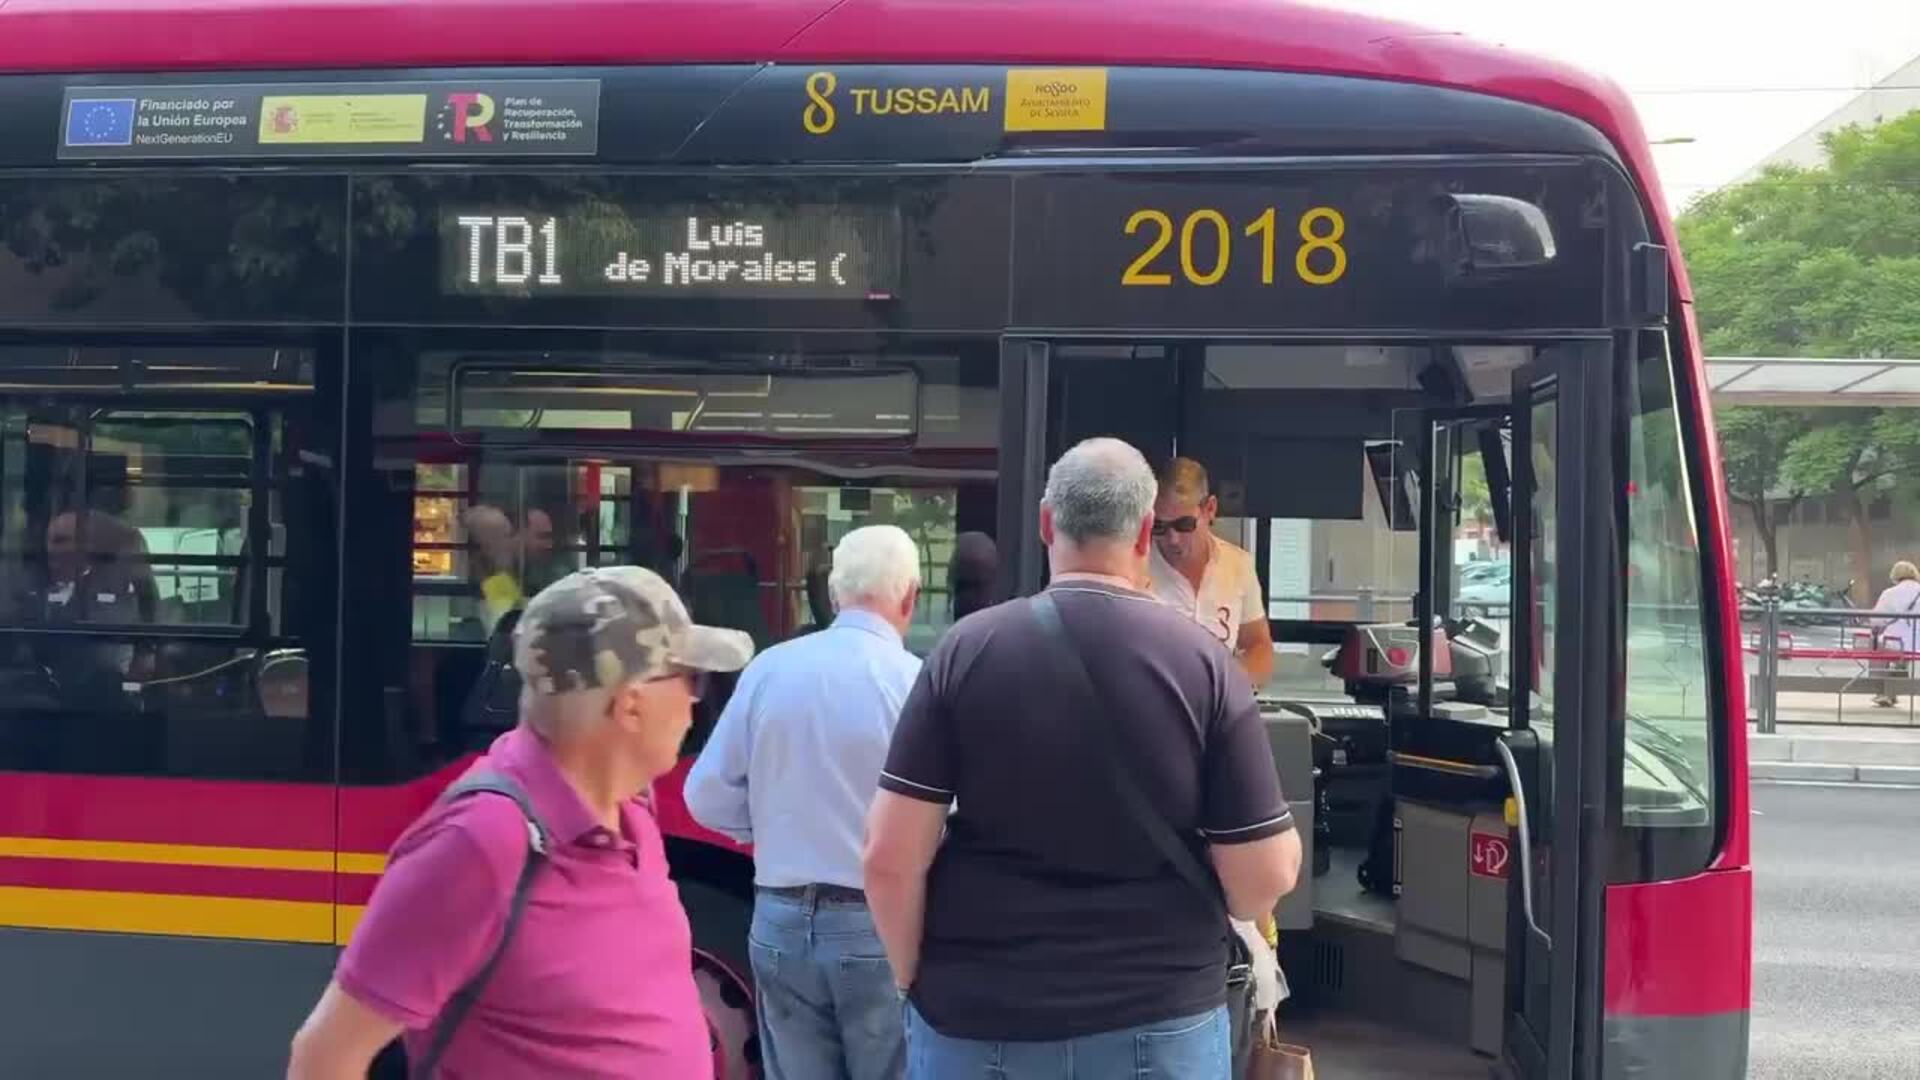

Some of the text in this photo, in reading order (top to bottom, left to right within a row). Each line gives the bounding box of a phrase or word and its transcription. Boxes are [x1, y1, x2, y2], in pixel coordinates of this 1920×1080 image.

[140, 99, 235, 113] Financiado por
[851, 87, 989, 115] TUSSAM
[137, 114, 247, 129] la Unión Europea
[136, 131, 233, 144] NextGenerationEU
[688, 217, 763, 250] Luis
[1121, 206, 1347, 285] 2018
[458, 216, 561, 284] TB1
[605, 252, 650, 282] de
[663, 252, 816, 285] Morales
